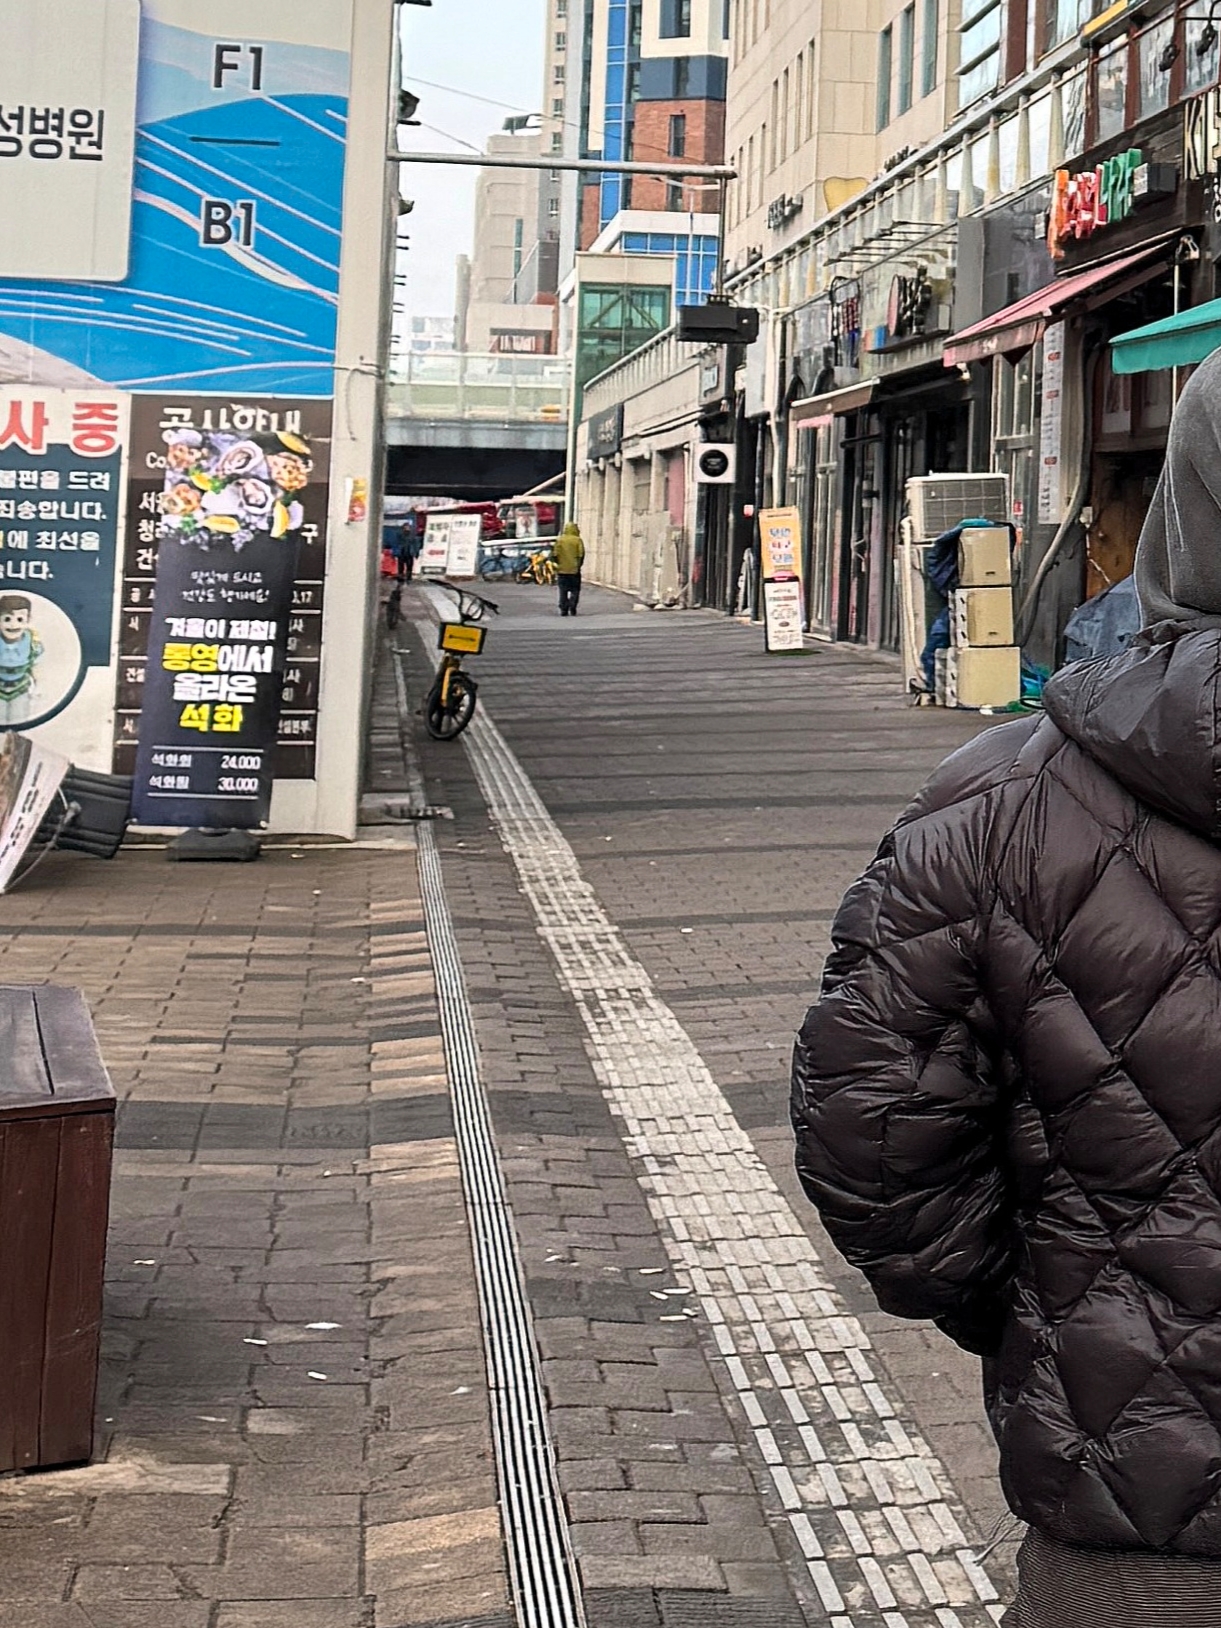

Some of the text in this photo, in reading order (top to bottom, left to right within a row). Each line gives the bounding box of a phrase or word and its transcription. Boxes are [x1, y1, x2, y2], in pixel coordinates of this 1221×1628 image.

[213, 44, 263, 90] F1
[203, 201, 253, 247] B1
[0, 560, 54, 580] 니다.
[162, 642, 274, 673] 통영에서
[173, 672, 258, 704] 올라온
[179, 703, 244, 732] 석화
